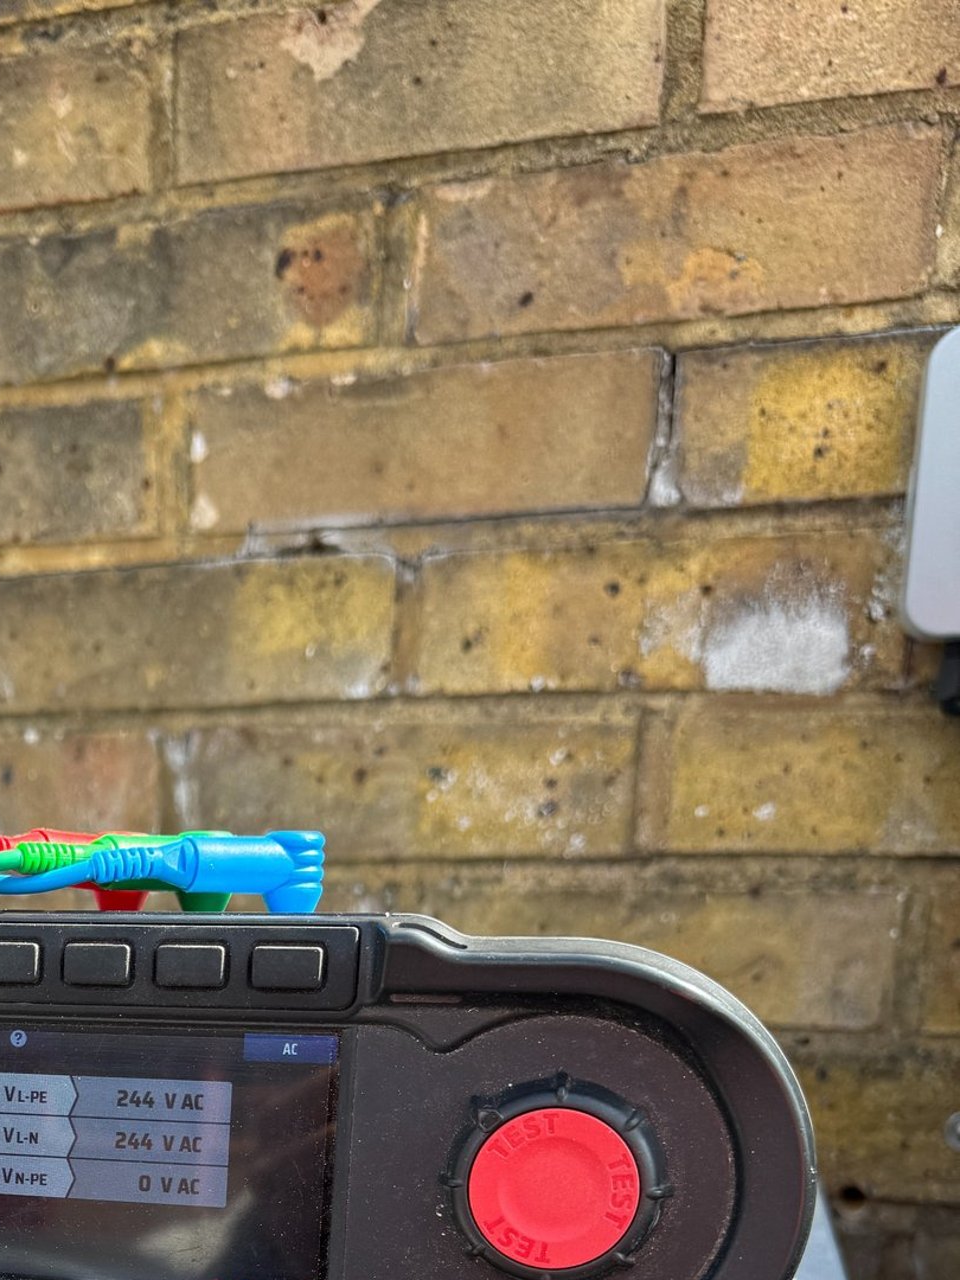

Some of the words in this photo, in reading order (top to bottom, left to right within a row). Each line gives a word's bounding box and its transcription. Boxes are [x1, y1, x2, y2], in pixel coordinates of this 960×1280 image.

[282, 1042, 299, 1056] AC
[116, 1089, 155, 1109] 244
[164, 1092, 177, 1110] V
[180, 1093, 204, 1111] AC
[114, 1131, 153, 1151] 244
[162, 1134, 175, 1152] V
[179, 1135, 202, 1153] AC
[487, 1112, 560, 1158] TEST
[160, 1176, 173, 1193] V
[177, 1177, 200, 1195] AC
[604, 1152, 635, 1231] TEST
[482, 1214, 551, 1264] TEST
